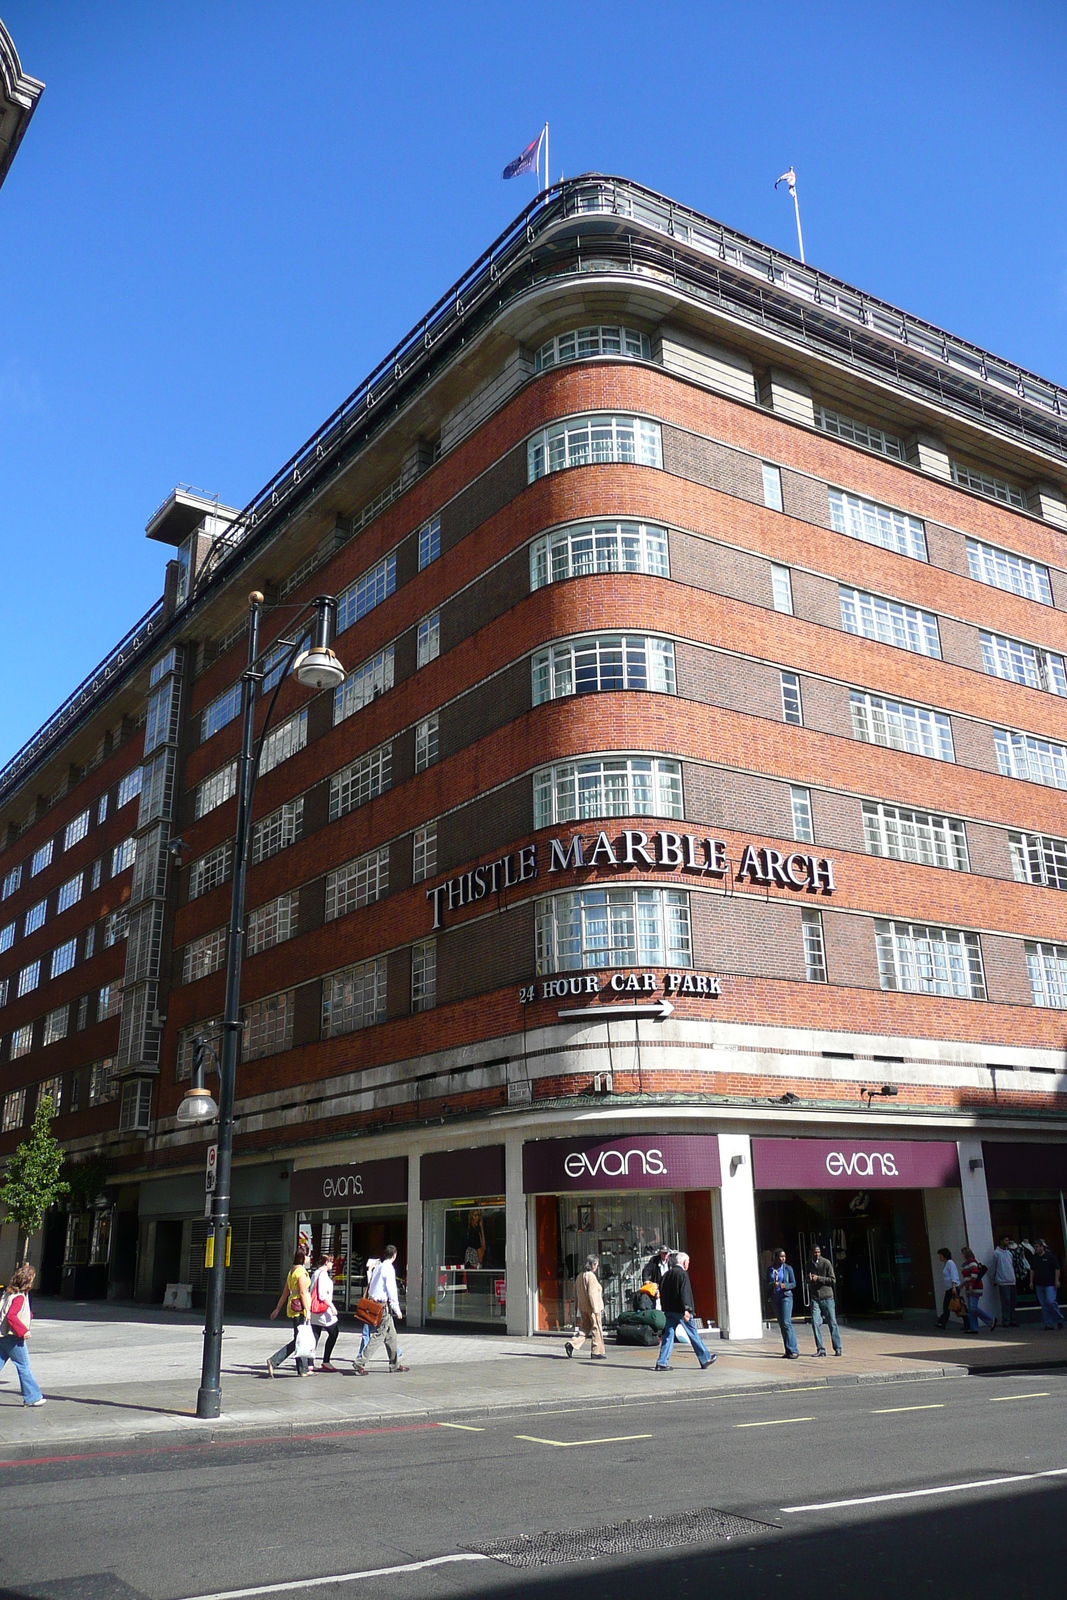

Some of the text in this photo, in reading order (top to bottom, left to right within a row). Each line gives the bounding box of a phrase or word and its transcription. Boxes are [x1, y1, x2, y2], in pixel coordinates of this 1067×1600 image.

[426, 830, 838, 930] THISTLE MARBLE ARCH
[519, 973, 723, 1004] 24 HOUR CAR PARK
